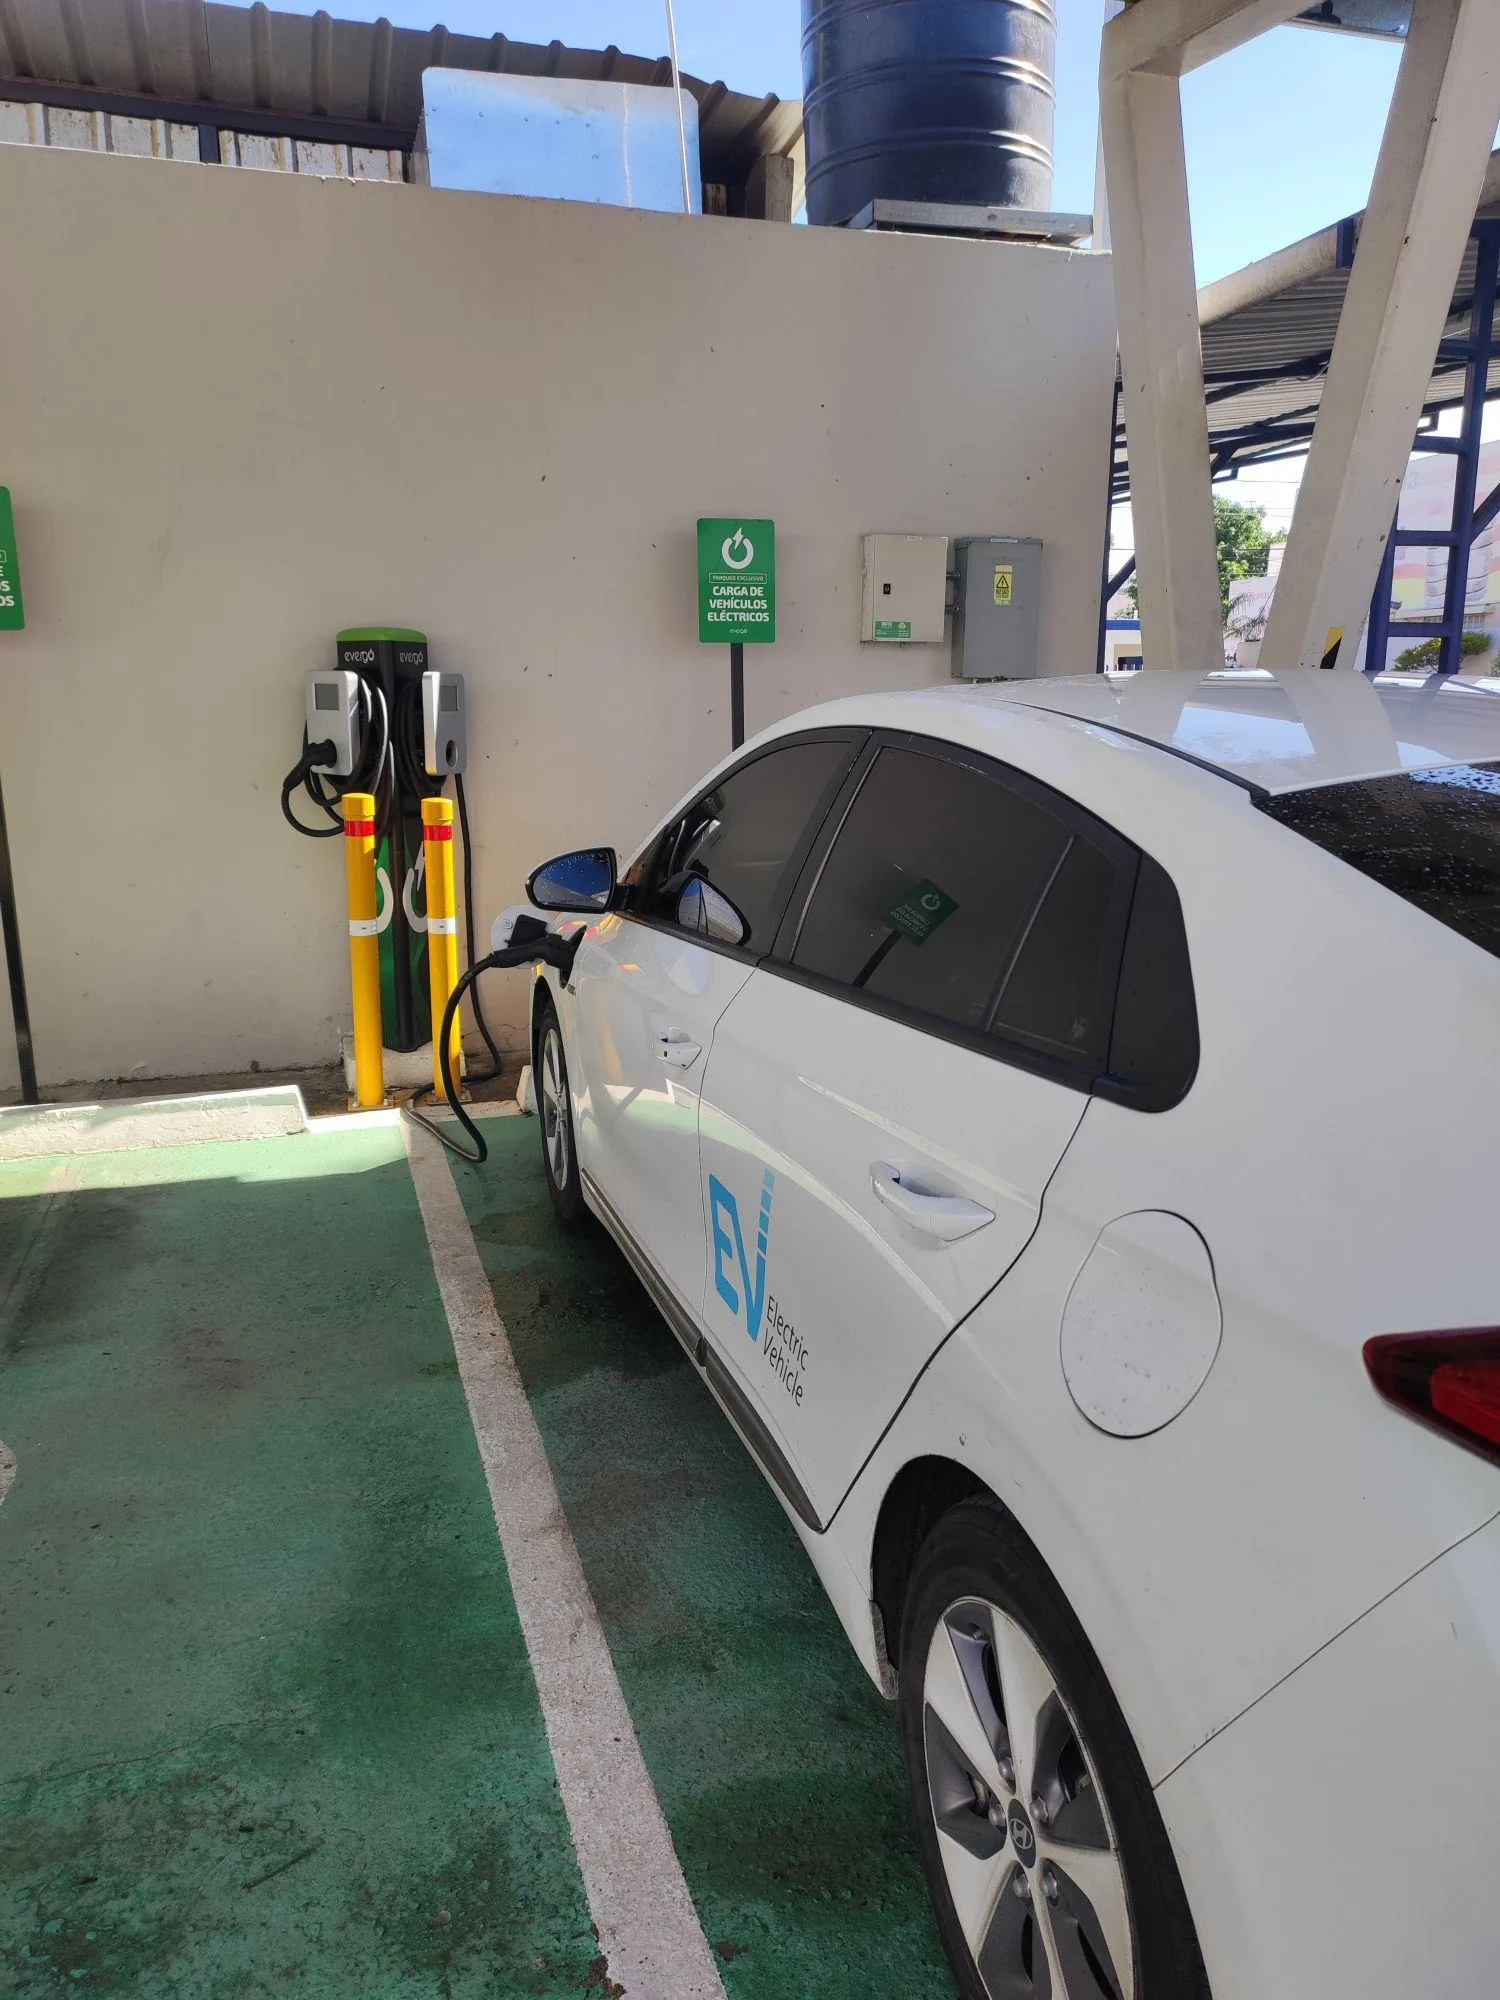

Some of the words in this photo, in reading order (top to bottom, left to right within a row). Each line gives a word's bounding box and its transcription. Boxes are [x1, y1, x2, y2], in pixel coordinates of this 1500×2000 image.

[713, 586, 749, 596] CARGA
[750, 586, 764, 596] DE
[709, 596, 768, 609] VEHÍCULOS
[707, 609, 770, 622] ELÉCTRICOS
[767, 1295, 809, 1372] Electric
[763, 1328, 804, 1407] Vehicle
